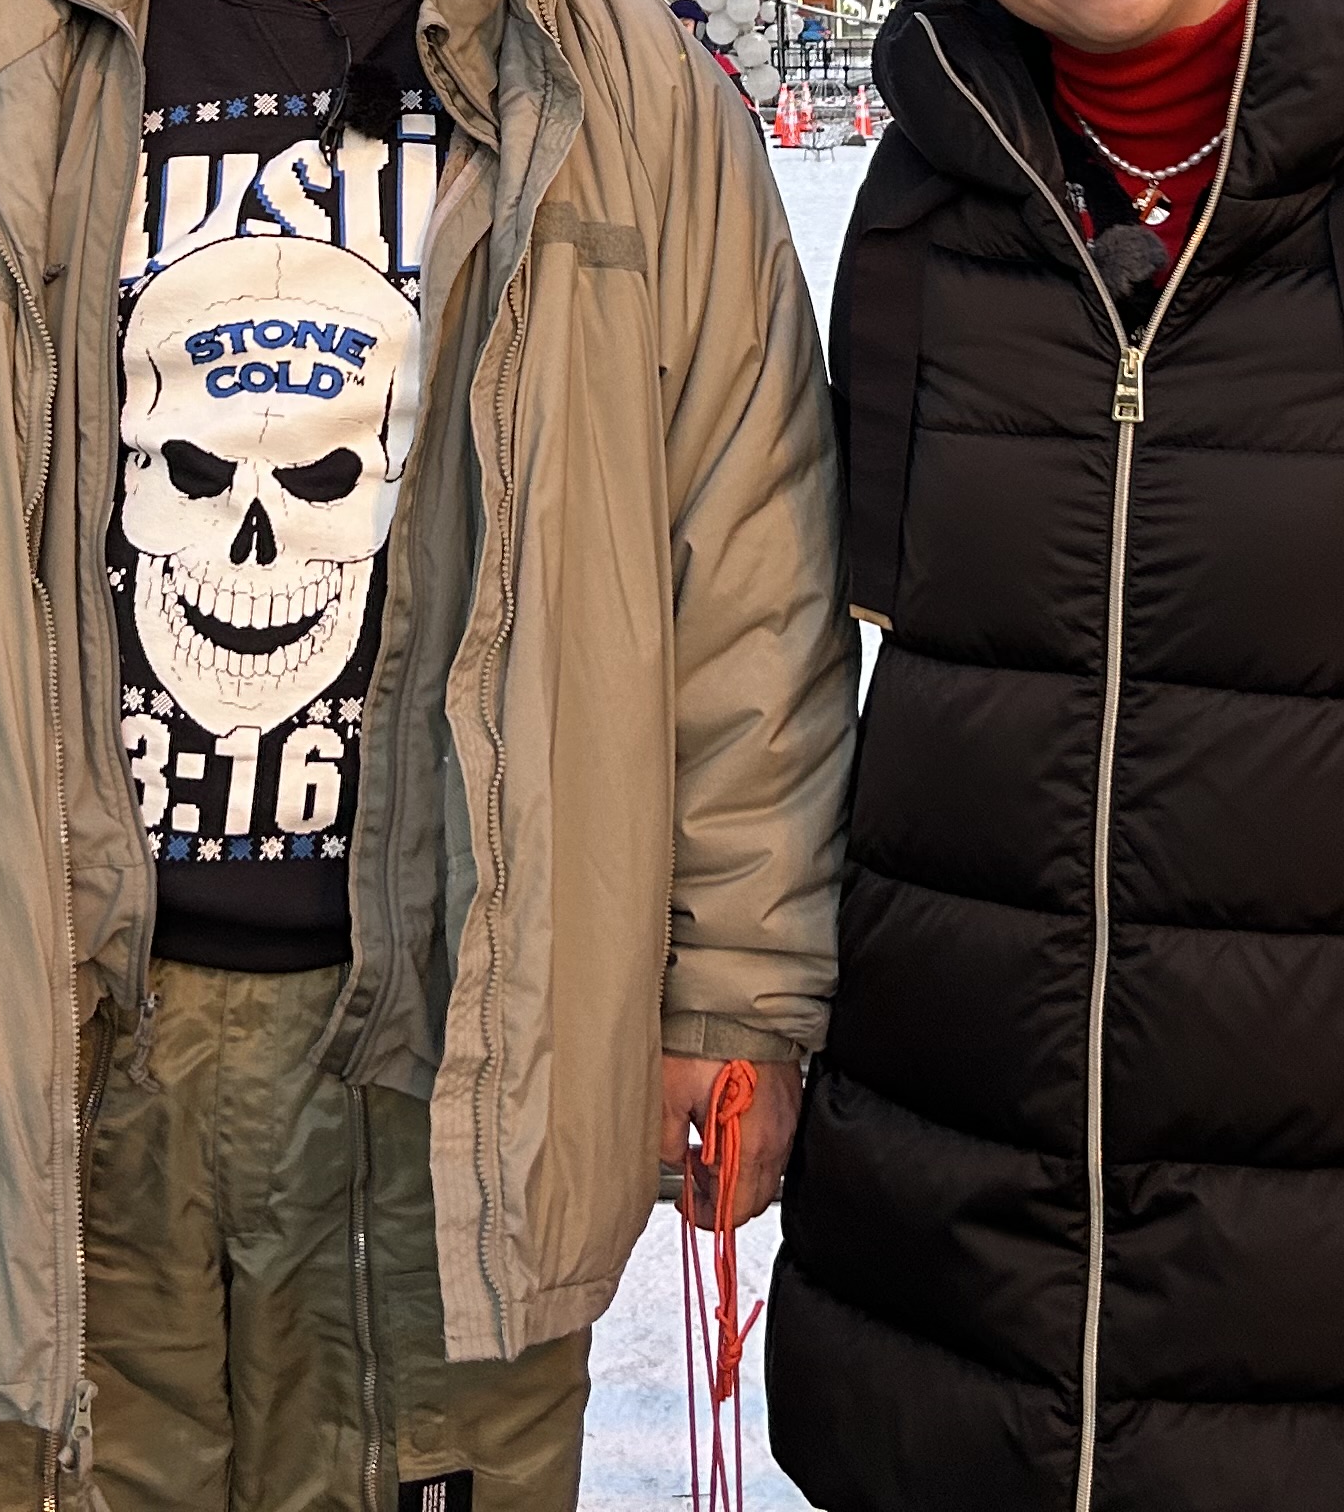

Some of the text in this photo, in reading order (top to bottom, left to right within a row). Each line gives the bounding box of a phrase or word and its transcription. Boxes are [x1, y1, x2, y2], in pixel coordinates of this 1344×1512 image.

[185, 319, 377, 369] STONE
[205, 361, 345, 399] COLD
[120, 713, 345, 835] 3:16
